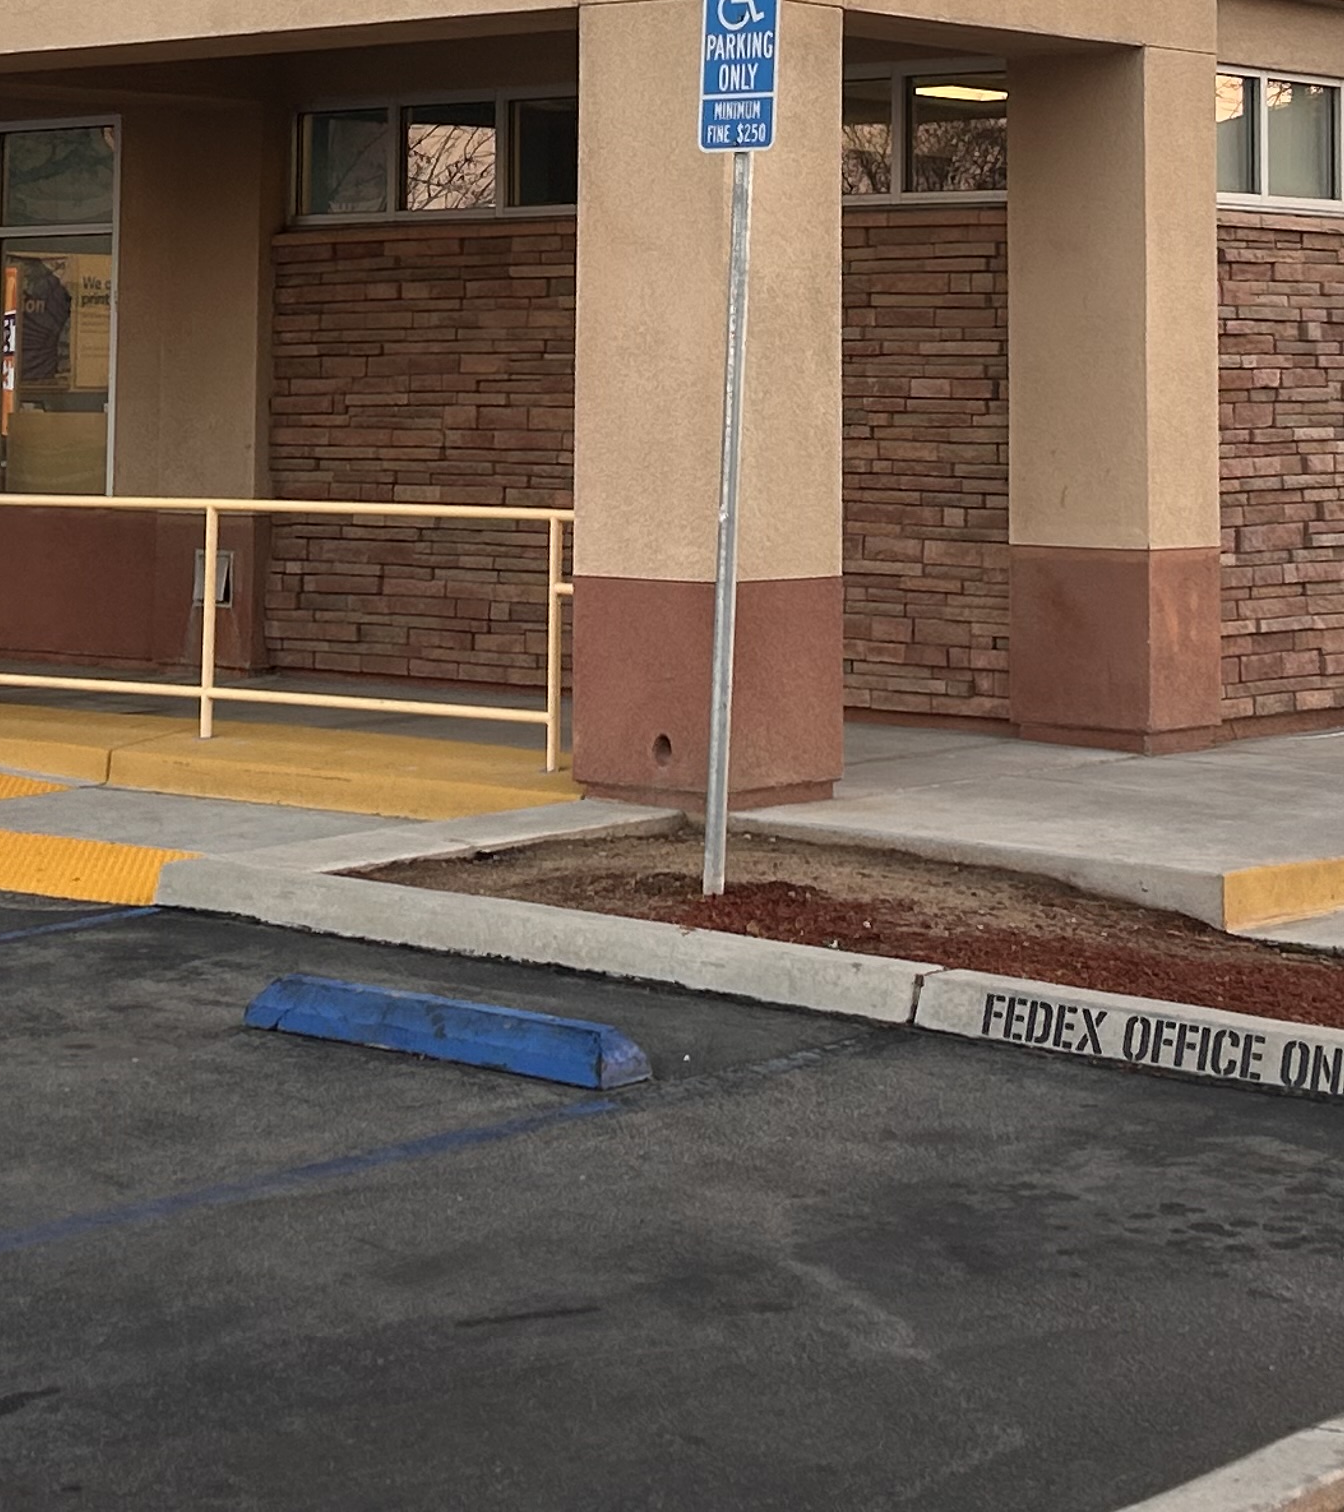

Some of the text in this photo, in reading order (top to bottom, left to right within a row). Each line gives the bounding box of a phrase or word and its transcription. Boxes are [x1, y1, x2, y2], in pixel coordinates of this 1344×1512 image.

[705, 30, 774, 61] PARKING
[718, 62, 759, 92] ONLY
[713, 100, 761, 121] MINIMUM
[706, 122, 767, 144] FINE $250
[981, 992, 1108, 1055] FEDEX
[1122, 1015, 1267, 1080] OFFICE
